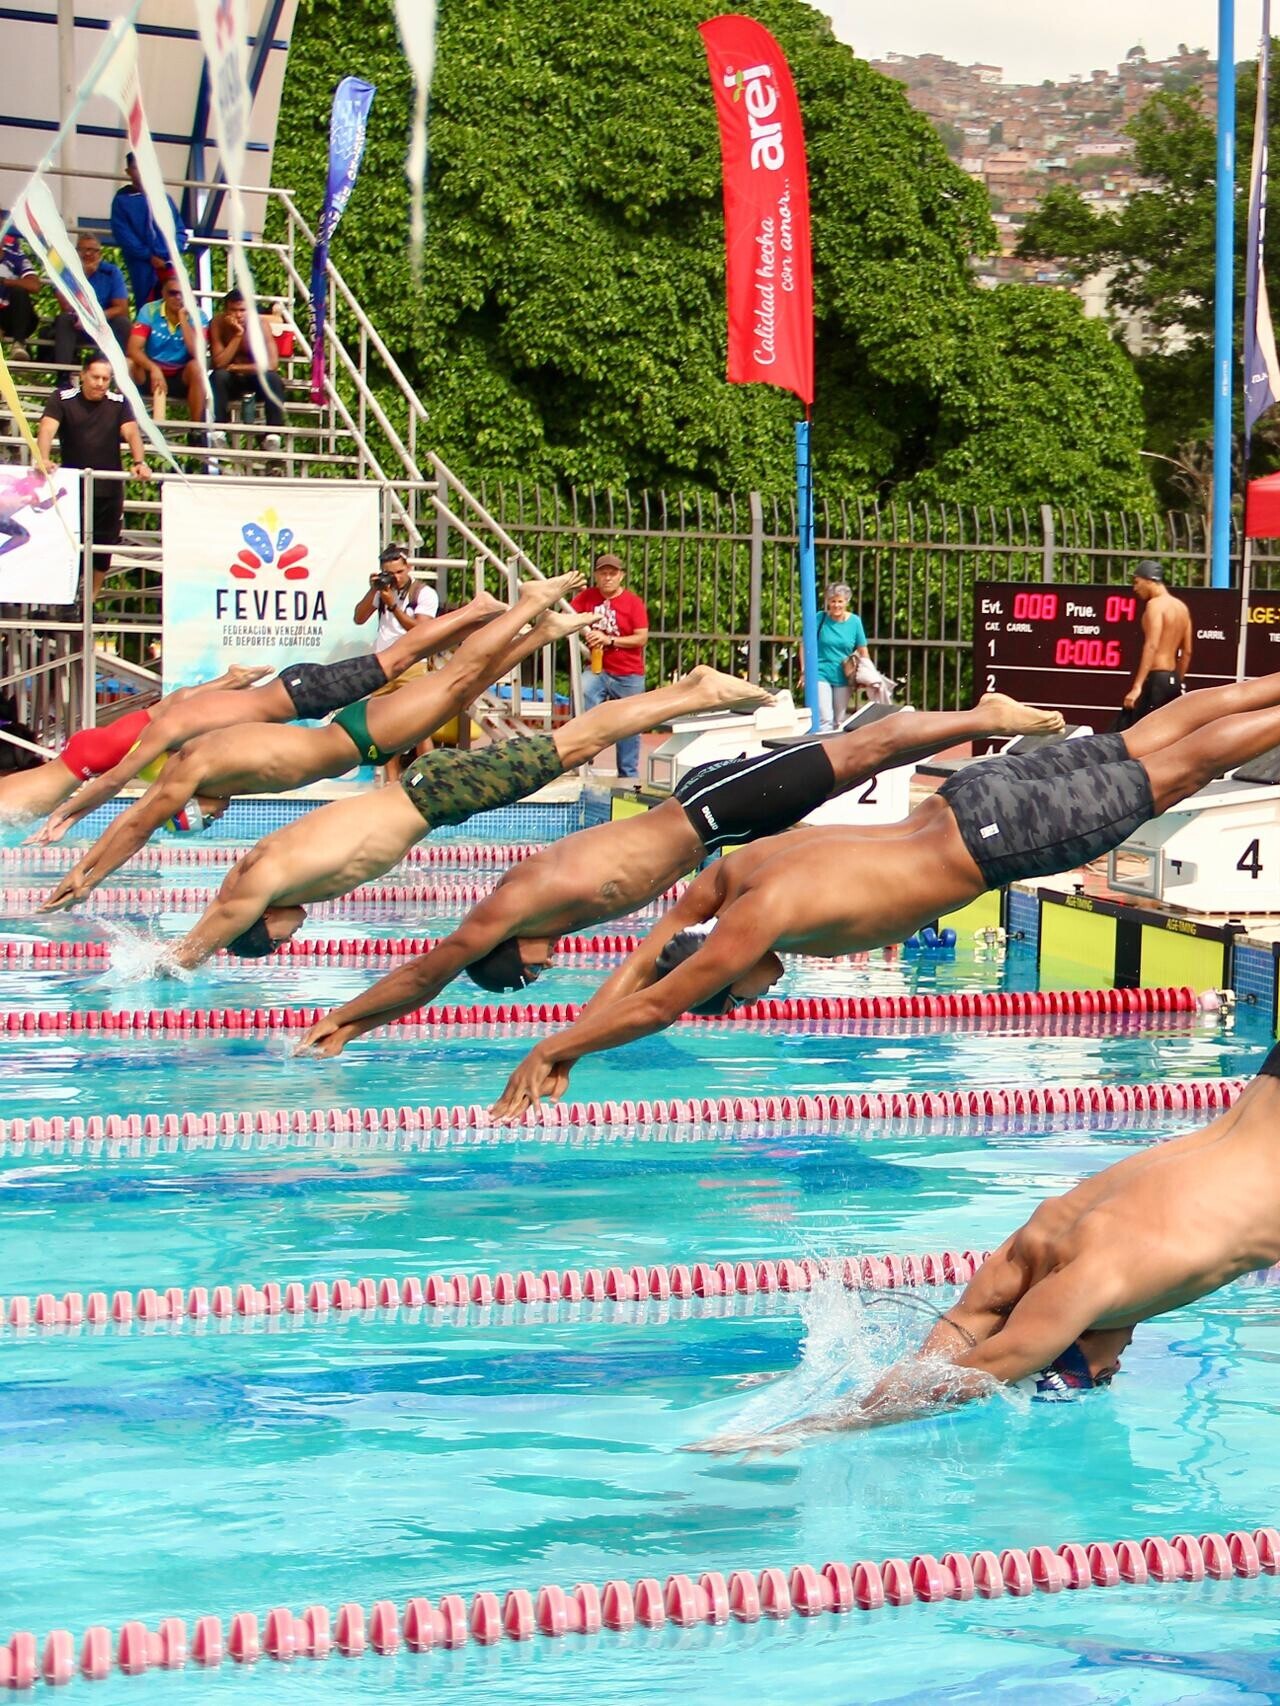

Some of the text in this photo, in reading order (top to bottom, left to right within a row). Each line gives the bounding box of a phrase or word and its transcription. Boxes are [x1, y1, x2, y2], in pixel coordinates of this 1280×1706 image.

[781, 256, 794, 292] con
[753, 216, 776, 365] Calidad hecha
[216, 589, 328, 621] FEVEDA
[981, 594, 1136, 622] Evt. 008 Prue. 04
[223, 636, 233, 647] DE
[236, 637, 276, 647] DEPORTES
[275, 626, 323, 637] VENEZOLANA
[1006, 622, 1032, 633] CARRIL
[1073, 625, 1100, 635] TIEMPO
[1197, 630, 1226, 640] CARRIL
[988, 639, 1121, 667] 1 0:00.6
[987, 674, 996, 692] 2
[858, 773, 878, 804] 2
[1237, 838, 1263, 880] 4
